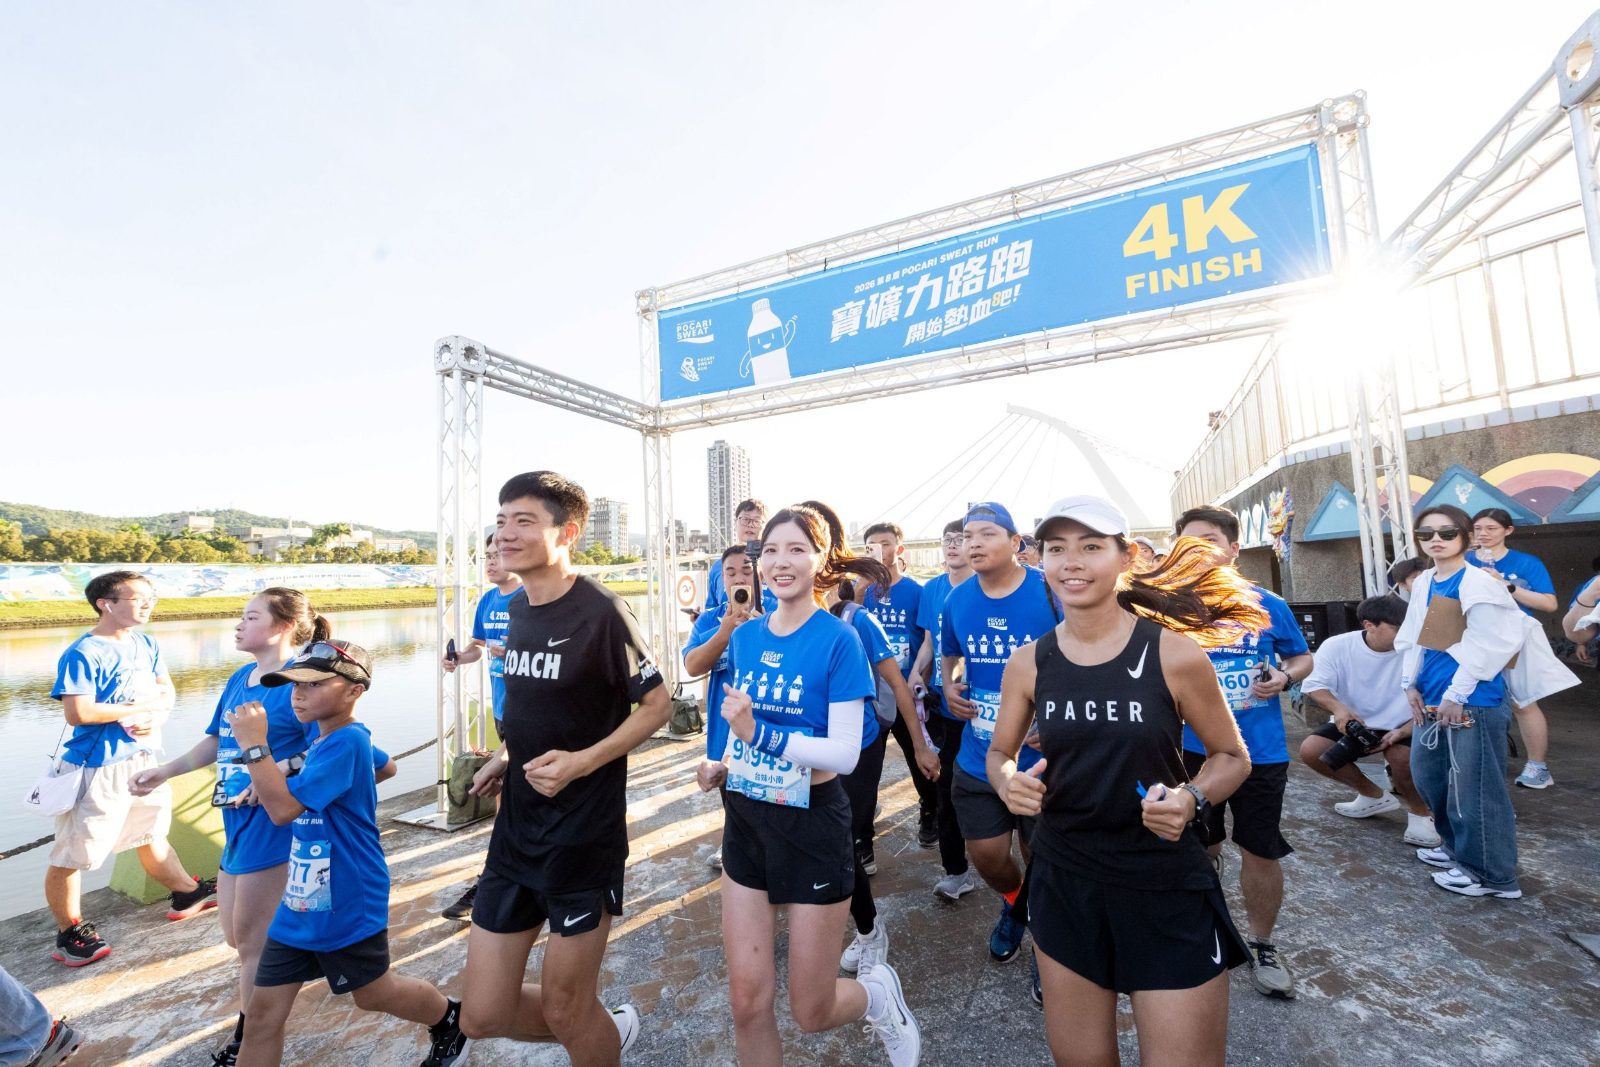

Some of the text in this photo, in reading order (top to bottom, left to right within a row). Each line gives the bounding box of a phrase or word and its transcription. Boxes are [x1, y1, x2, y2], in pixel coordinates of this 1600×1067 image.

[1122, 182, 1258, 261] 4K
[854, 280, 875, 294] 2026
[901, 257, 937, 277] POCARI
[940, 244, 974, 263] SWEAT
[976, 234, 999, 250] RUN
[1125, 247, 1262, 299] FINISH
[830, 239, 1033, 343] 寶礦力路跑
[676, 318, 712, 332] POCARI
[676, 326, 709, 340] SWEAT
[1223, 647, 1246, 655] SWEAT
[503, 649, 562, 680] COACH
[762, 703, 784, 713] SWEAT
[785, 707, 804, 715] RUN
[1045, 700, 1144, 722] PACER
